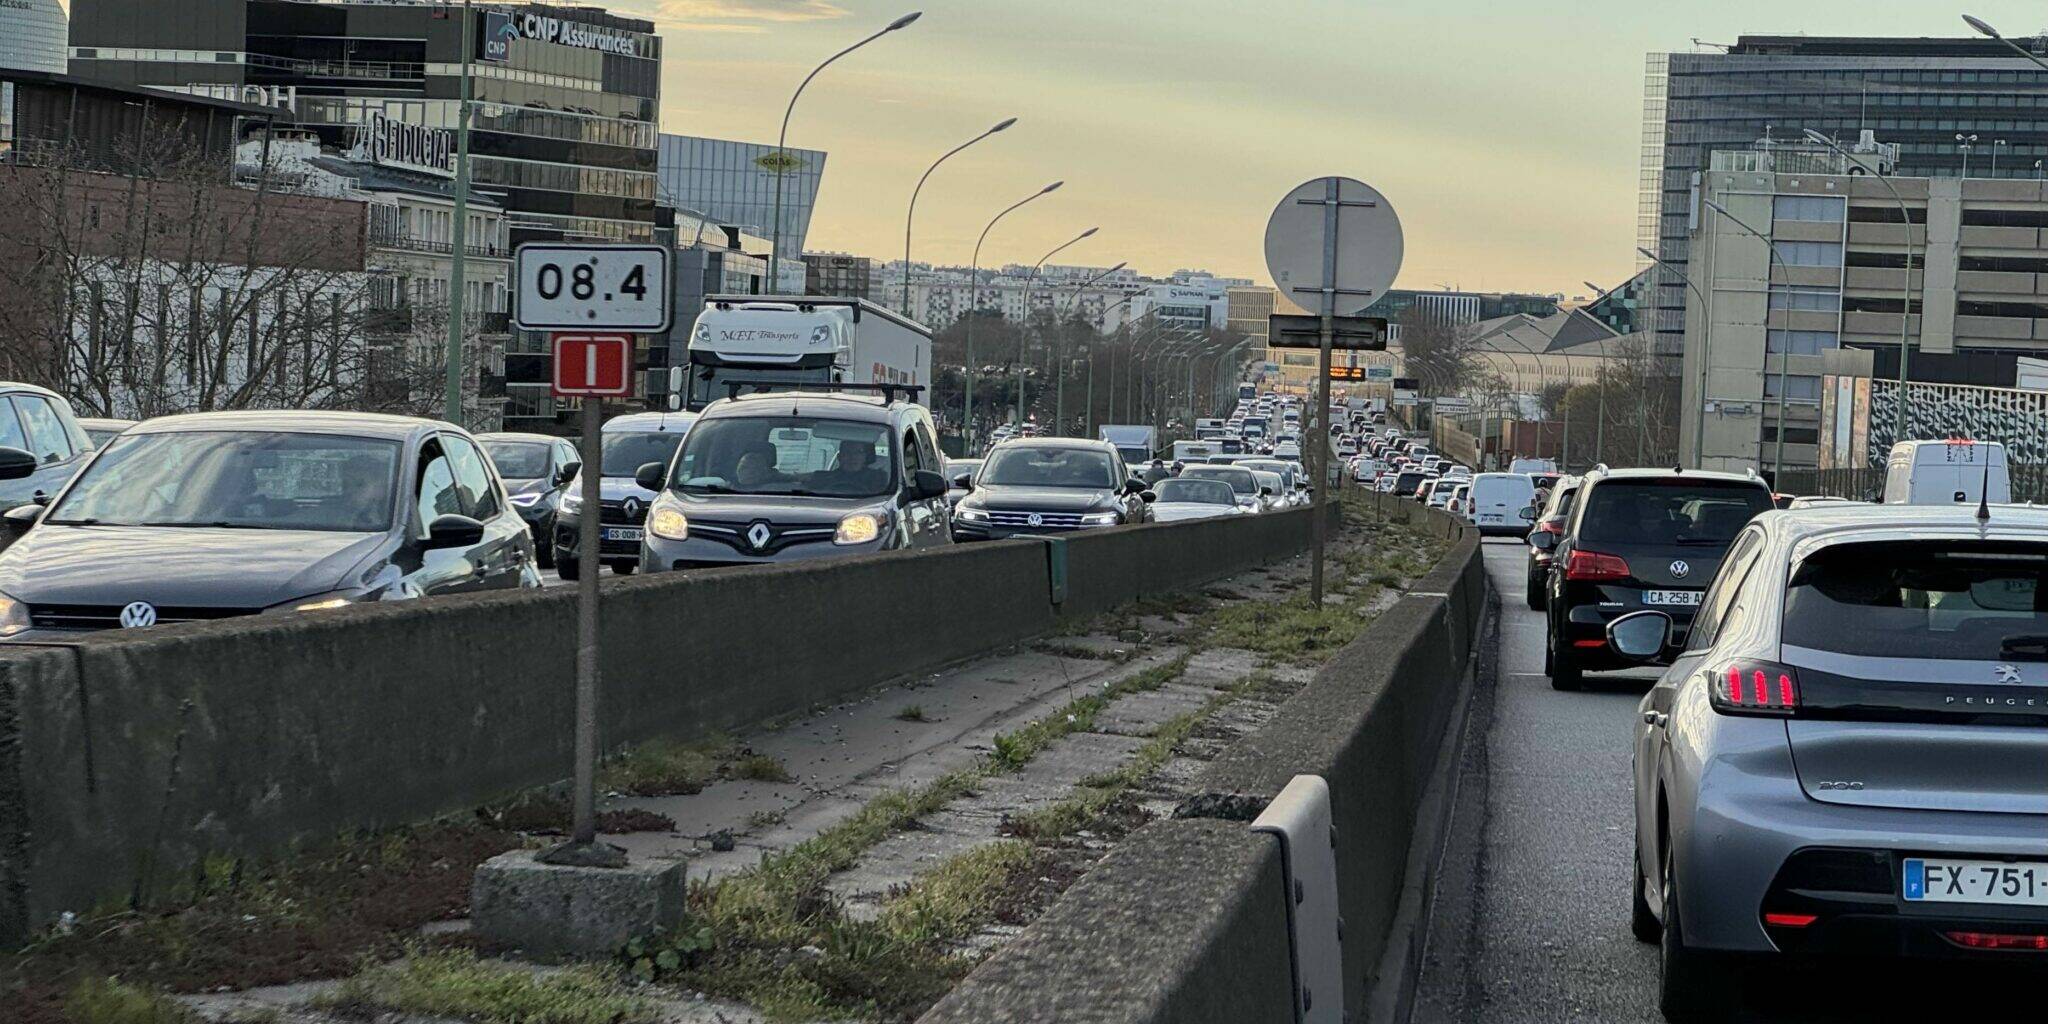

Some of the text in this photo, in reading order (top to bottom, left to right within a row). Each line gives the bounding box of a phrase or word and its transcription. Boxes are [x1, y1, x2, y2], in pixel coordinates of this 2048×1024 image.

[524, 13, 634, 54] CNP Assurances
[487, 40, 506, 55] CNP
[537, 263, 647, 301] 08.4
[1945, 696, 2048, 706] PEUGE
